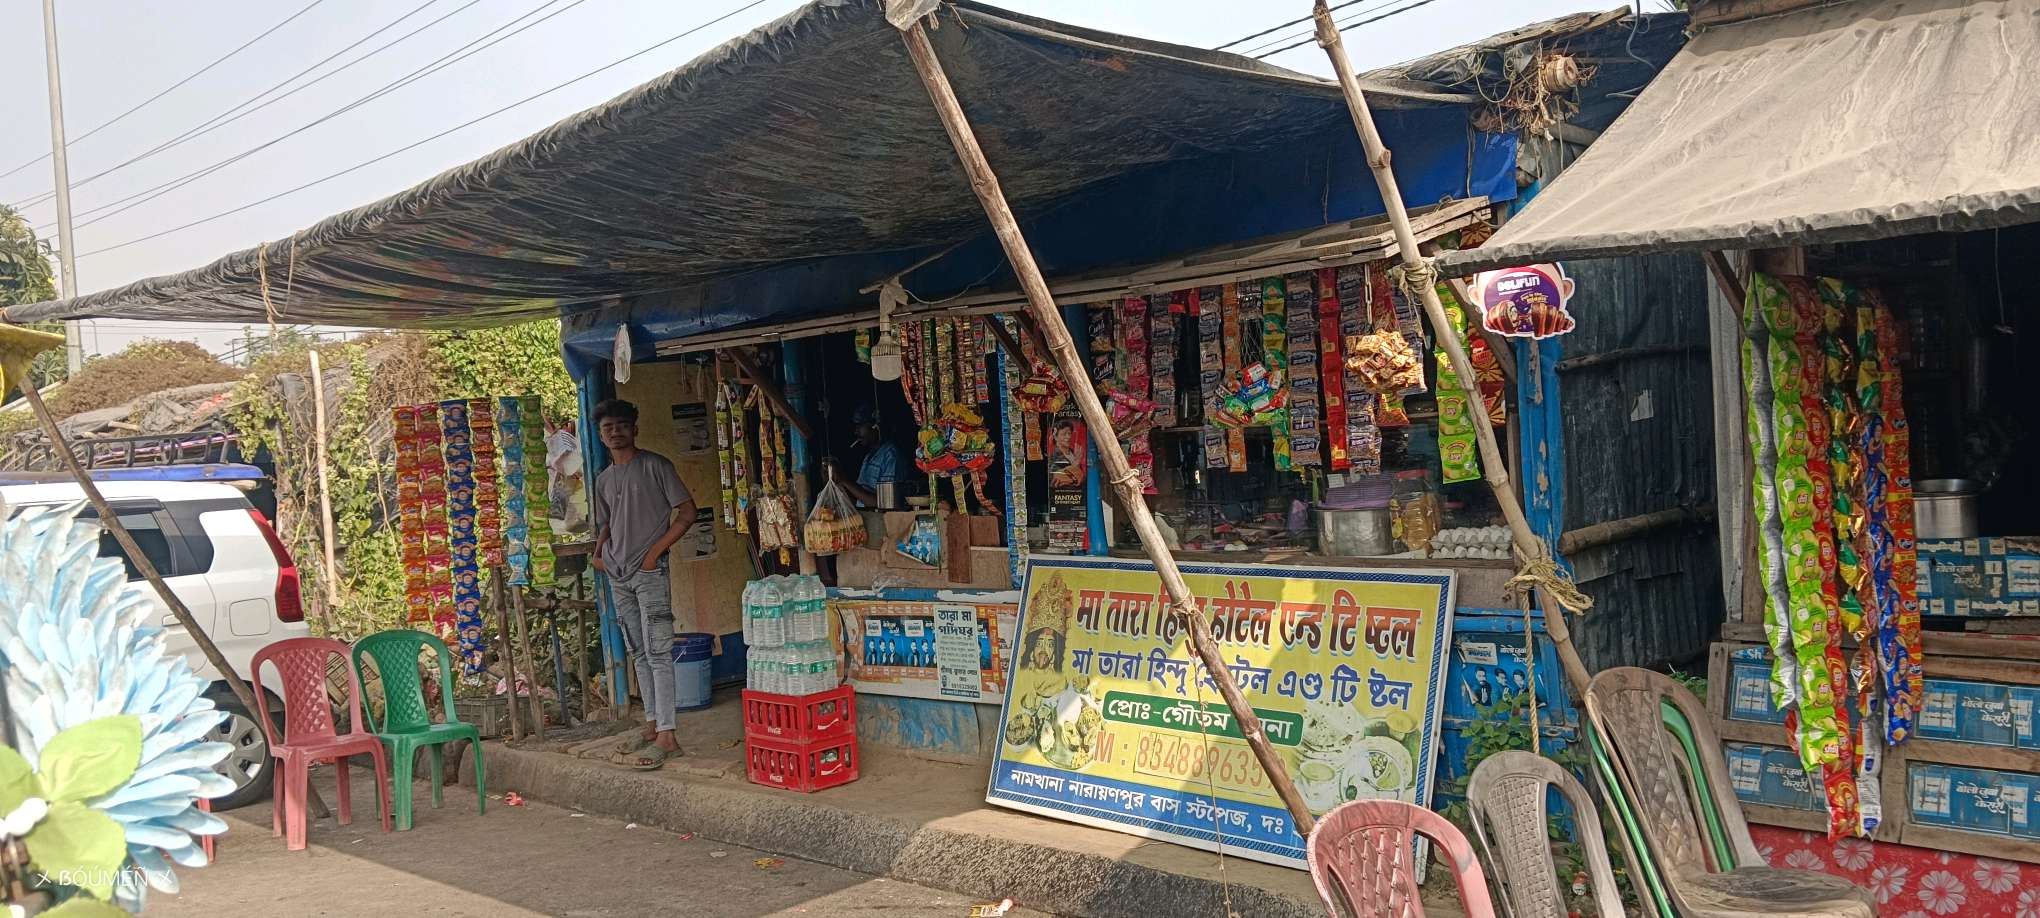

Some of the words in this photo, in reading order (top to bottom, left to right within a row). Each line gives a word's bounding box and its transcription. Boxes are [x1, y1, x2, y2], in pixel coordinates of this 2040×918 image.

[938, 610, 958, 622] তারা
[961, 610, 972, 622] মা
[1076, 590, 1105, 630] मा
[1106, 592, 1154, 637] तारा
[1329, 589, 1361, 652] टि
[1072, 648, 1093, 675] মা
[1098, 650, 1142, 680] তারা
[1147, 647, 1190, 696] হিন্দু
[1330, 663, 1361, 703] টি
[1258, 716, 1295, 740] ানা
[1094, 730, 1115, 763] M
[1136, 736, 1287, 790] 834889635
[1011, 769, 1064, 794] নামখানা
[1068, 780, 1146, 809] নারায়ণপুর
